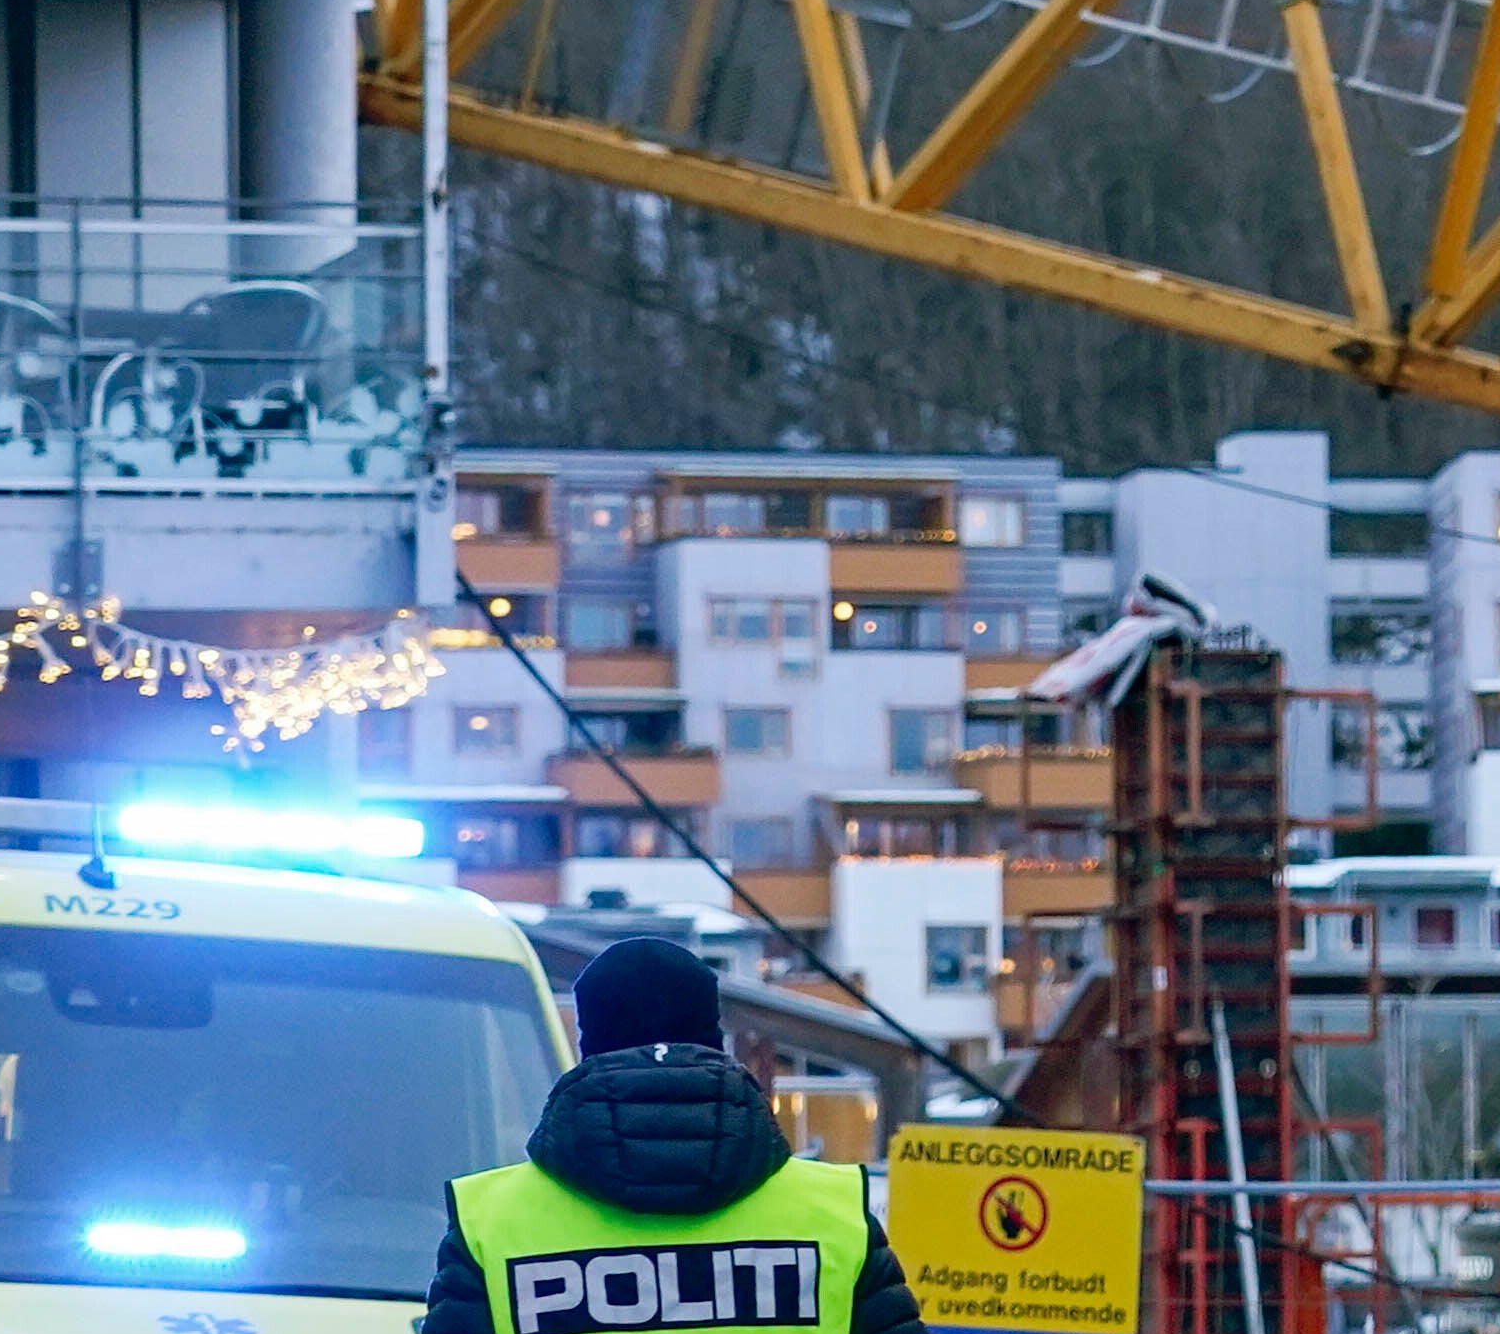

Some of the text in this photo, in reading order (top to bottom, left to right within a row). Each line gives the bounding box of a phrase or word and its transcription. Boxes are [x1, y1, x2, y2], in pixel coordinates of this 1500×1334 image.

[44, 894, 181, 920] M229
[514, 1247, 817, 1334] POLITI
[917, 1264, 1106, 1294] Adgang forbudt
[937, 1296, 1127, 1325] uvedkommende
